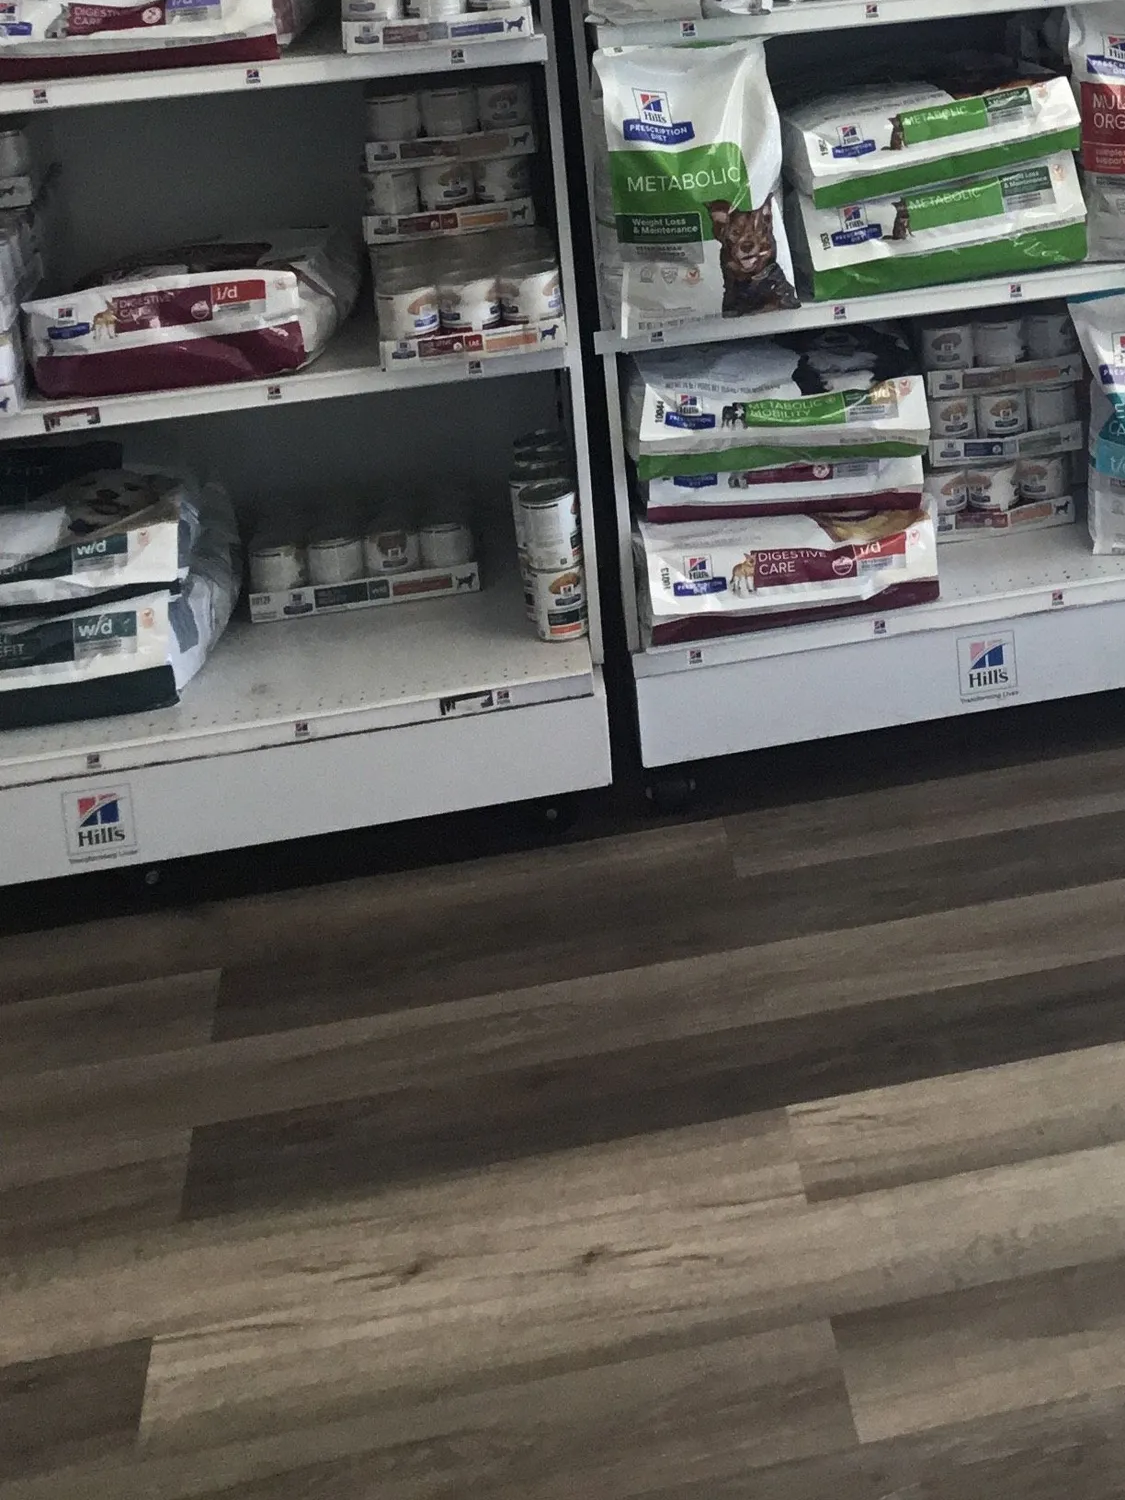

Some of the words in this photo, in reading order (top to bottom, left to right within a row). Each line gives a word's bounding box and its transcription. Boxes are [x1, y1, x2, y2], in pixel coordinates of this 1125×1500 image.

[644, 111, 667, 123] Hill's
[650, 133, 668, 142] DIET
[627, 165, 741, 192] METABOLIC
[908, 186, 981, 210] METABOLIC
[76, 540, 107, 556] w/d
[758, 550, 827, 562] DIGESTIVE
[759, 561, 796, 575] CARE
[78, 617, 113, 637] w/d
[969, 669, 1009, 688] Hill's
[78, 826, 125, 847] Hill's
